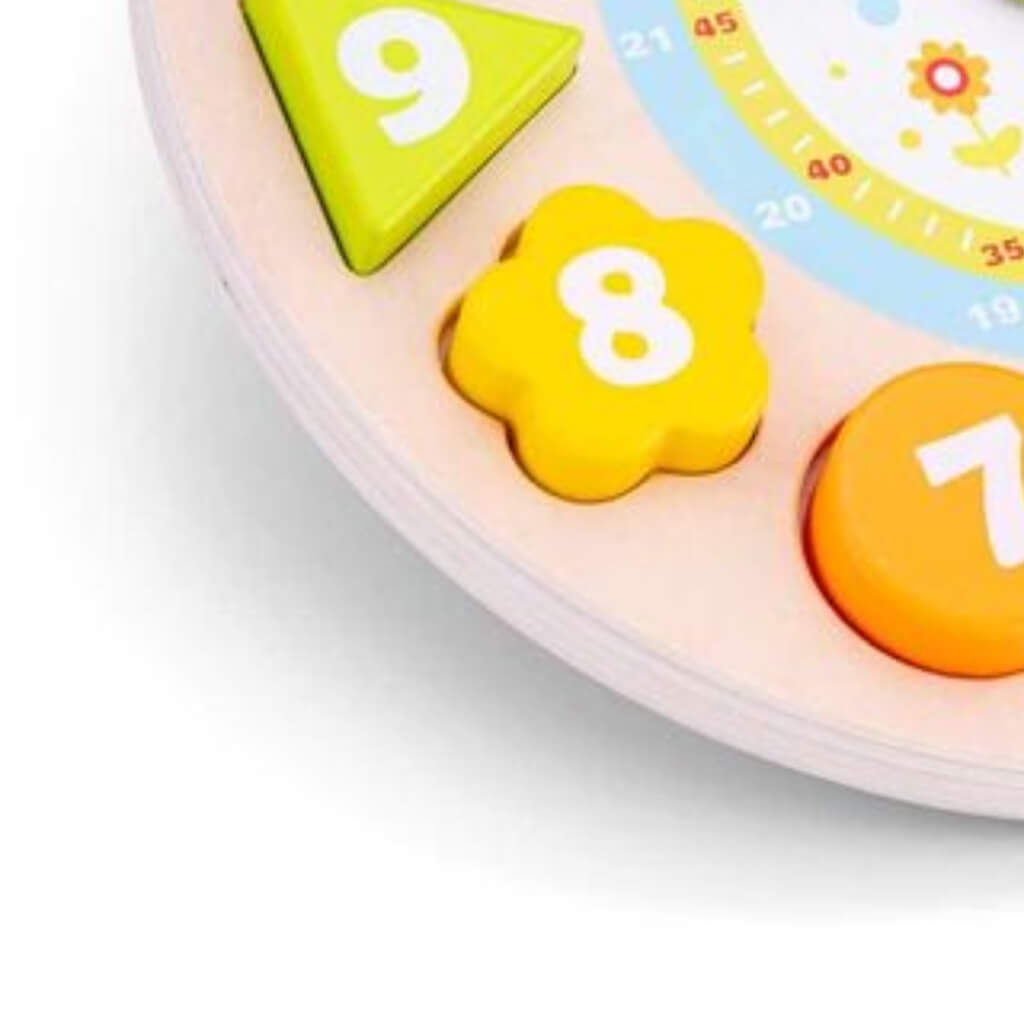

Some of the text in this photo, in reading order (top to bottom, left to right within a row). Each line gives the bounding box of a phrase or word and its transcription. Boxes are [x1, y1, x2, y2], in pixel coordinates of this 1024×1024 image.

[619, 24, 672, 59] 21
[693, 10, 738, 38] 45
[338, 9, 469, 144] 9
[806, 153, 852, 180] 40
[753, 193, 812, 230] 20
[981, 237, 1024, 267] 35
[558, 247, 694, 386] 8
[967, 293, 1022, 330] 19
